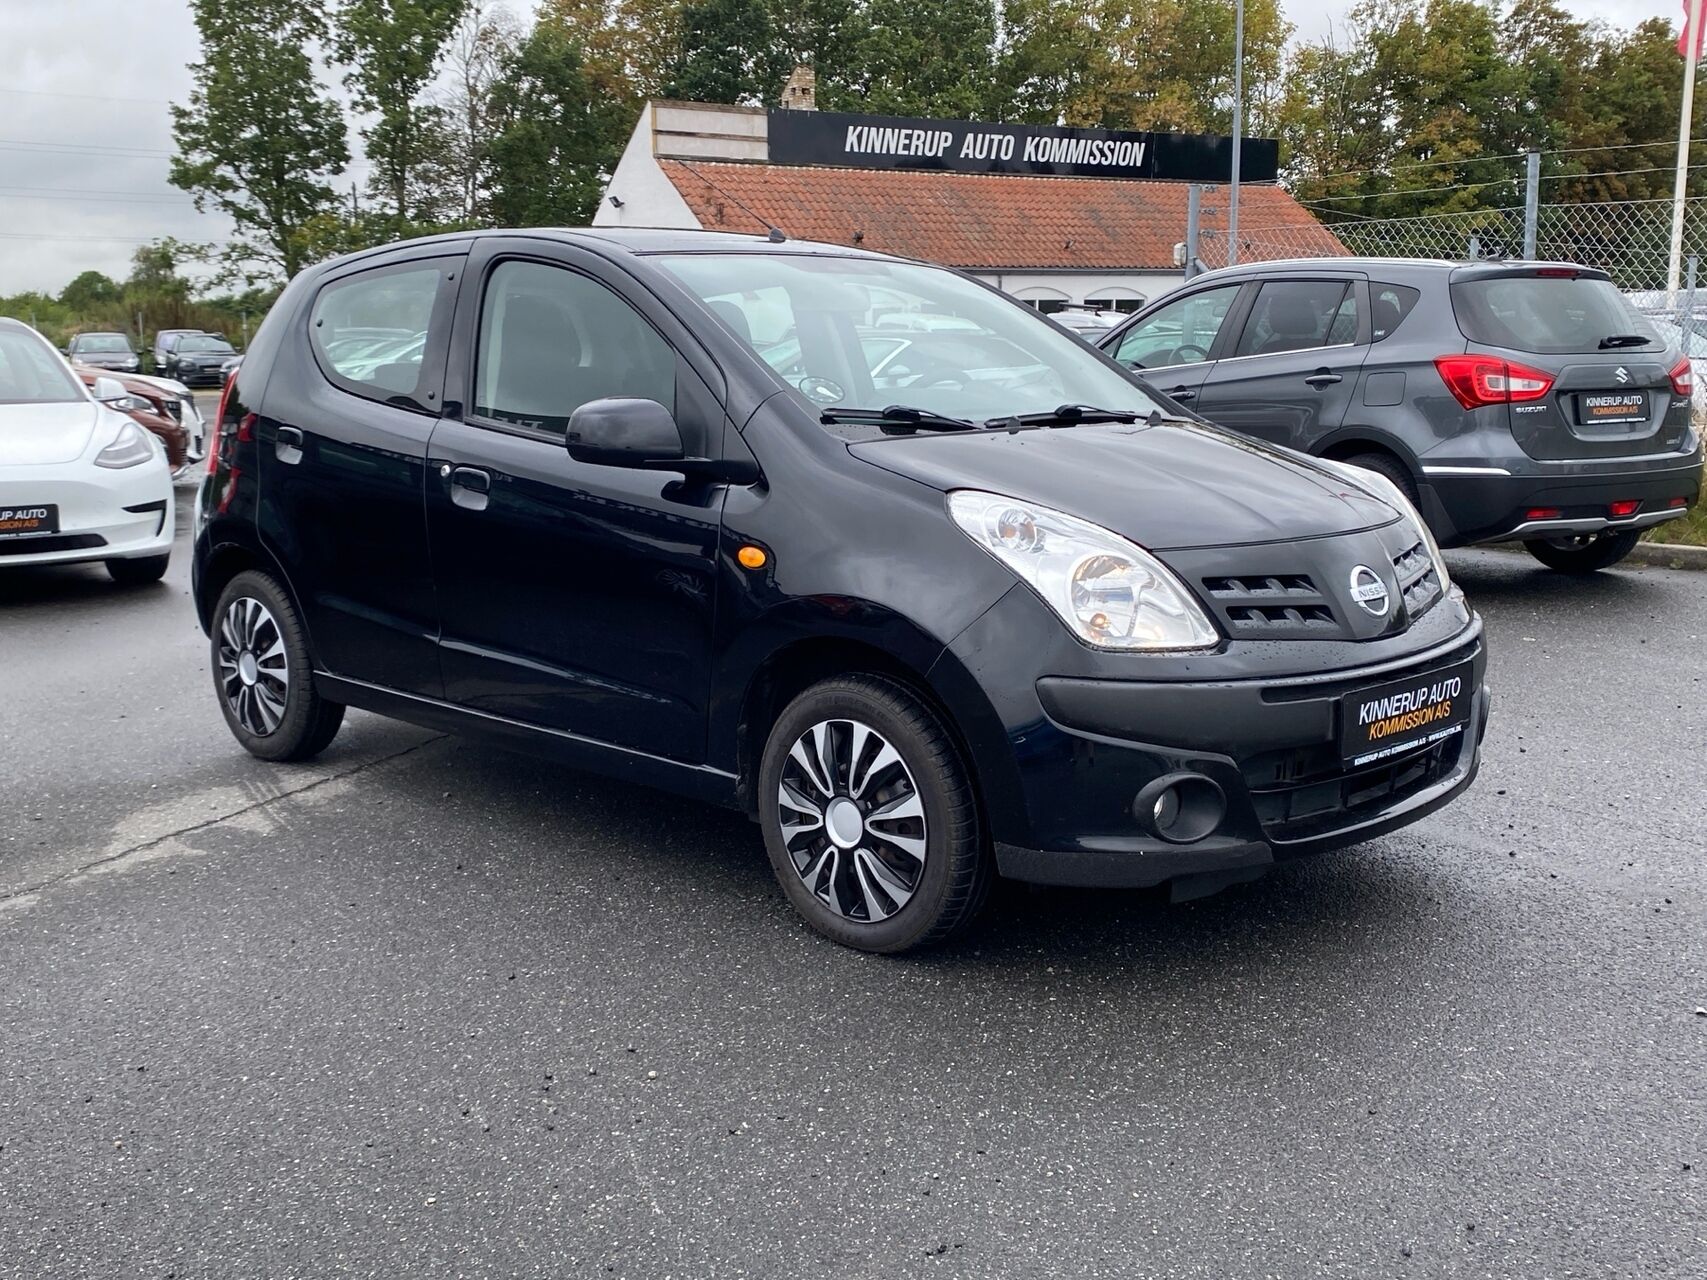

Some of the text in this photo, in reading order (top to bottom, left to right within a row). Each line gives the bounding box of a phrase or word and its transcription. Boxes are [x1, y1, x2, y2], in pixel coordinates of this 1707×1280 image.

[844, 125, 1146, 167] KINNERUP AUTO KOMMISSION
[1586, 395, 1643, 407] KINNERUP AUTO
[14, 508, 47, 519] AUTO
[1359, 677, 1461, 726] KINNERUP AUTO
[1369, 705, 1434, 740] KOMMISSION
[1434, 701, 1451, 720] A/S
